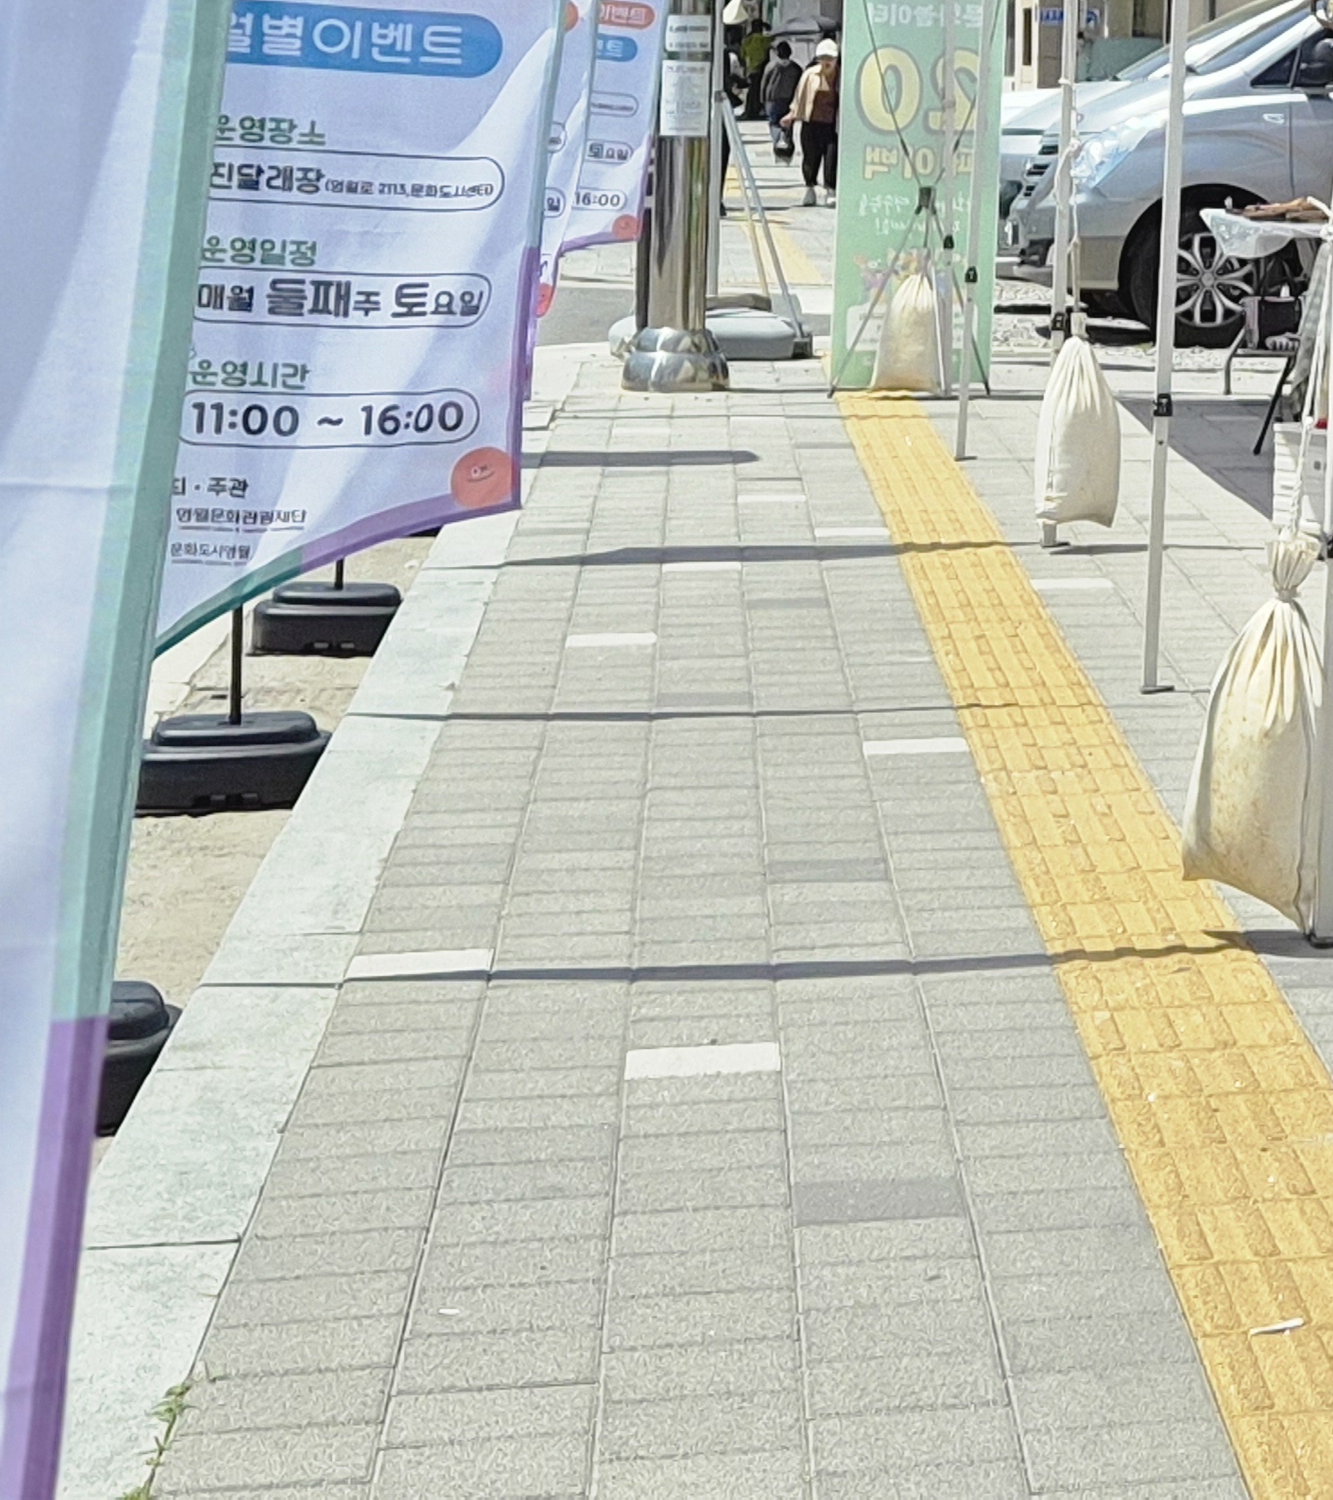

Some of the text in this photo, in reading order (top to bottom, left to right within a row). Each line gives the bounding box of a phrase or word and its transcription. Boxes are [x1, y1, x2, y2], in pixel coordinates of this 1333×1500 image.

[215, 114, 326, 146] 운영장소
[209, 161, 325, 194] 진달래장
[200, 235, 317, 267] 운영일정
[198, 278, 483, 318] 매월 둘째주 토요일
[188, 358, 311, 390] 운영시간
[192, 401, 300, 437] 11:00
[361, 401, 465, 436] 16:00
